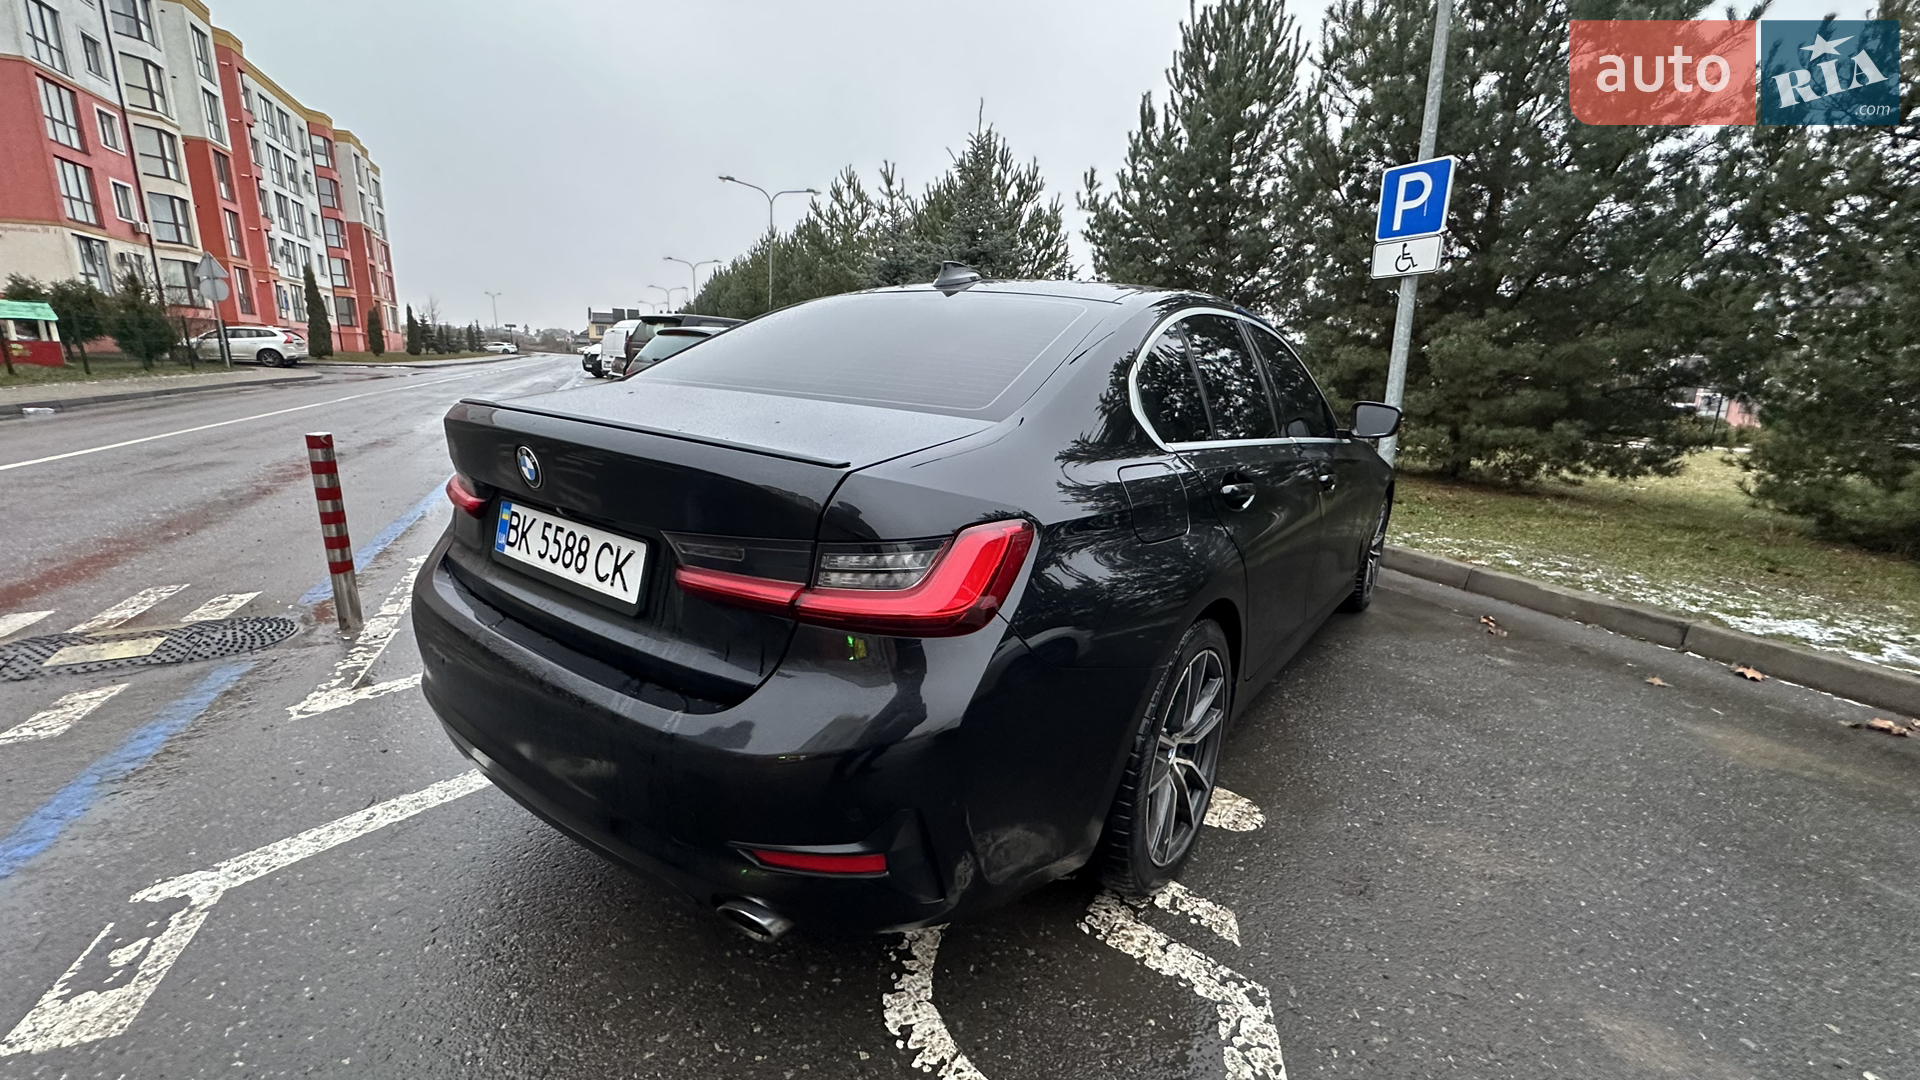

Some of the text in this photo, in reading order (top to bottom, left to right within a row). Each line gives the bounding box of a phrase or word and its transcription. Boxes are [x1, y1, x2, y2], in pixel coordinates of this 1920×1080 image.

[1392, 171, 1433, 231] P
[506, 511, 636, 592] BK 5588 CK
